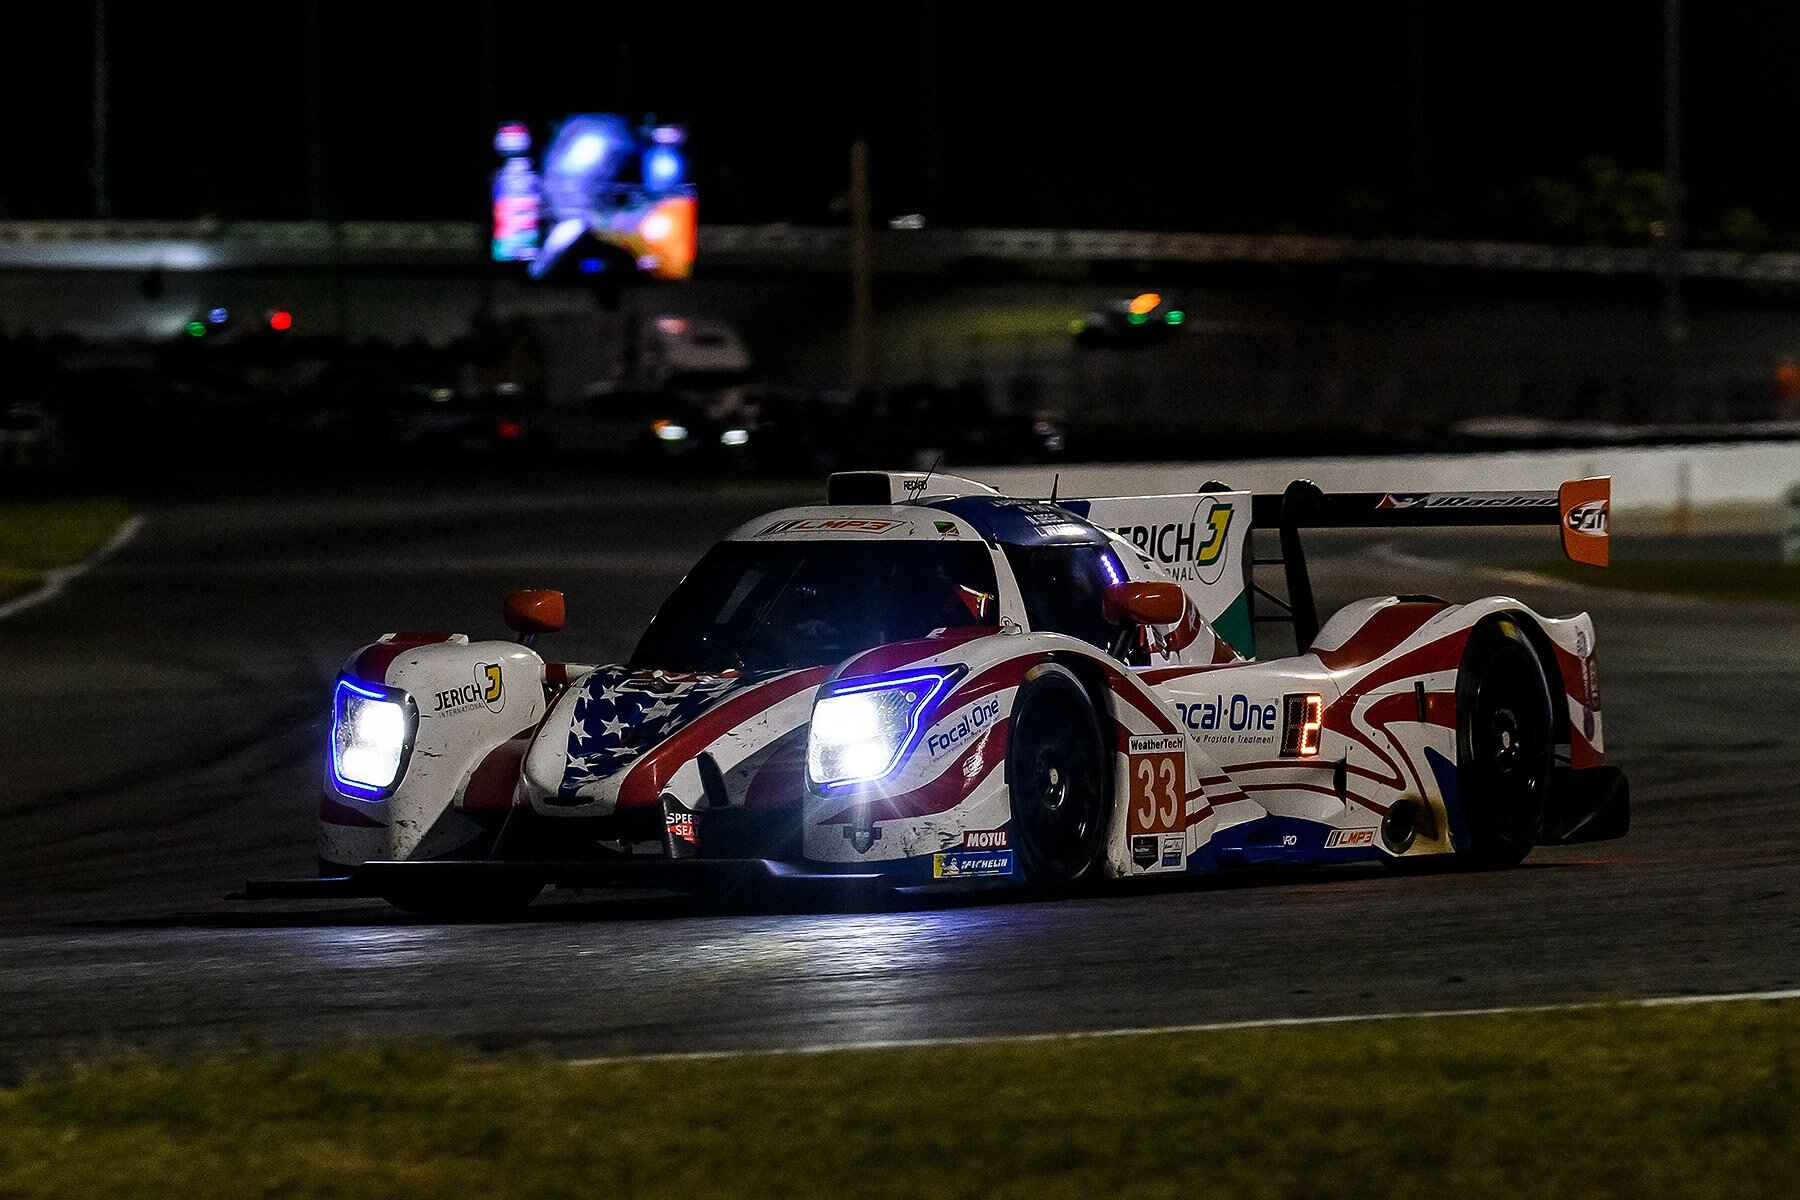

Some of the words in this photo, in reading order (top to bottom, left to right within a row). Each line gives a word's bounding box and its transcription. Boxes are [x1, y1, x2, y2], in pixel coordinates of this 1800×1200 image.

[797, 519, 891, 530] LMP3
[434, 683, 483, 711] JERICH
[1203, 734, 1235, 745] Prostate
[1238, 734, 1274, 744] Treatment
[1137, 758, 1178, 830] 33
[966, 831, 1007, 848] MOTUL
[1340, 831, 1374, 845] LMP3
